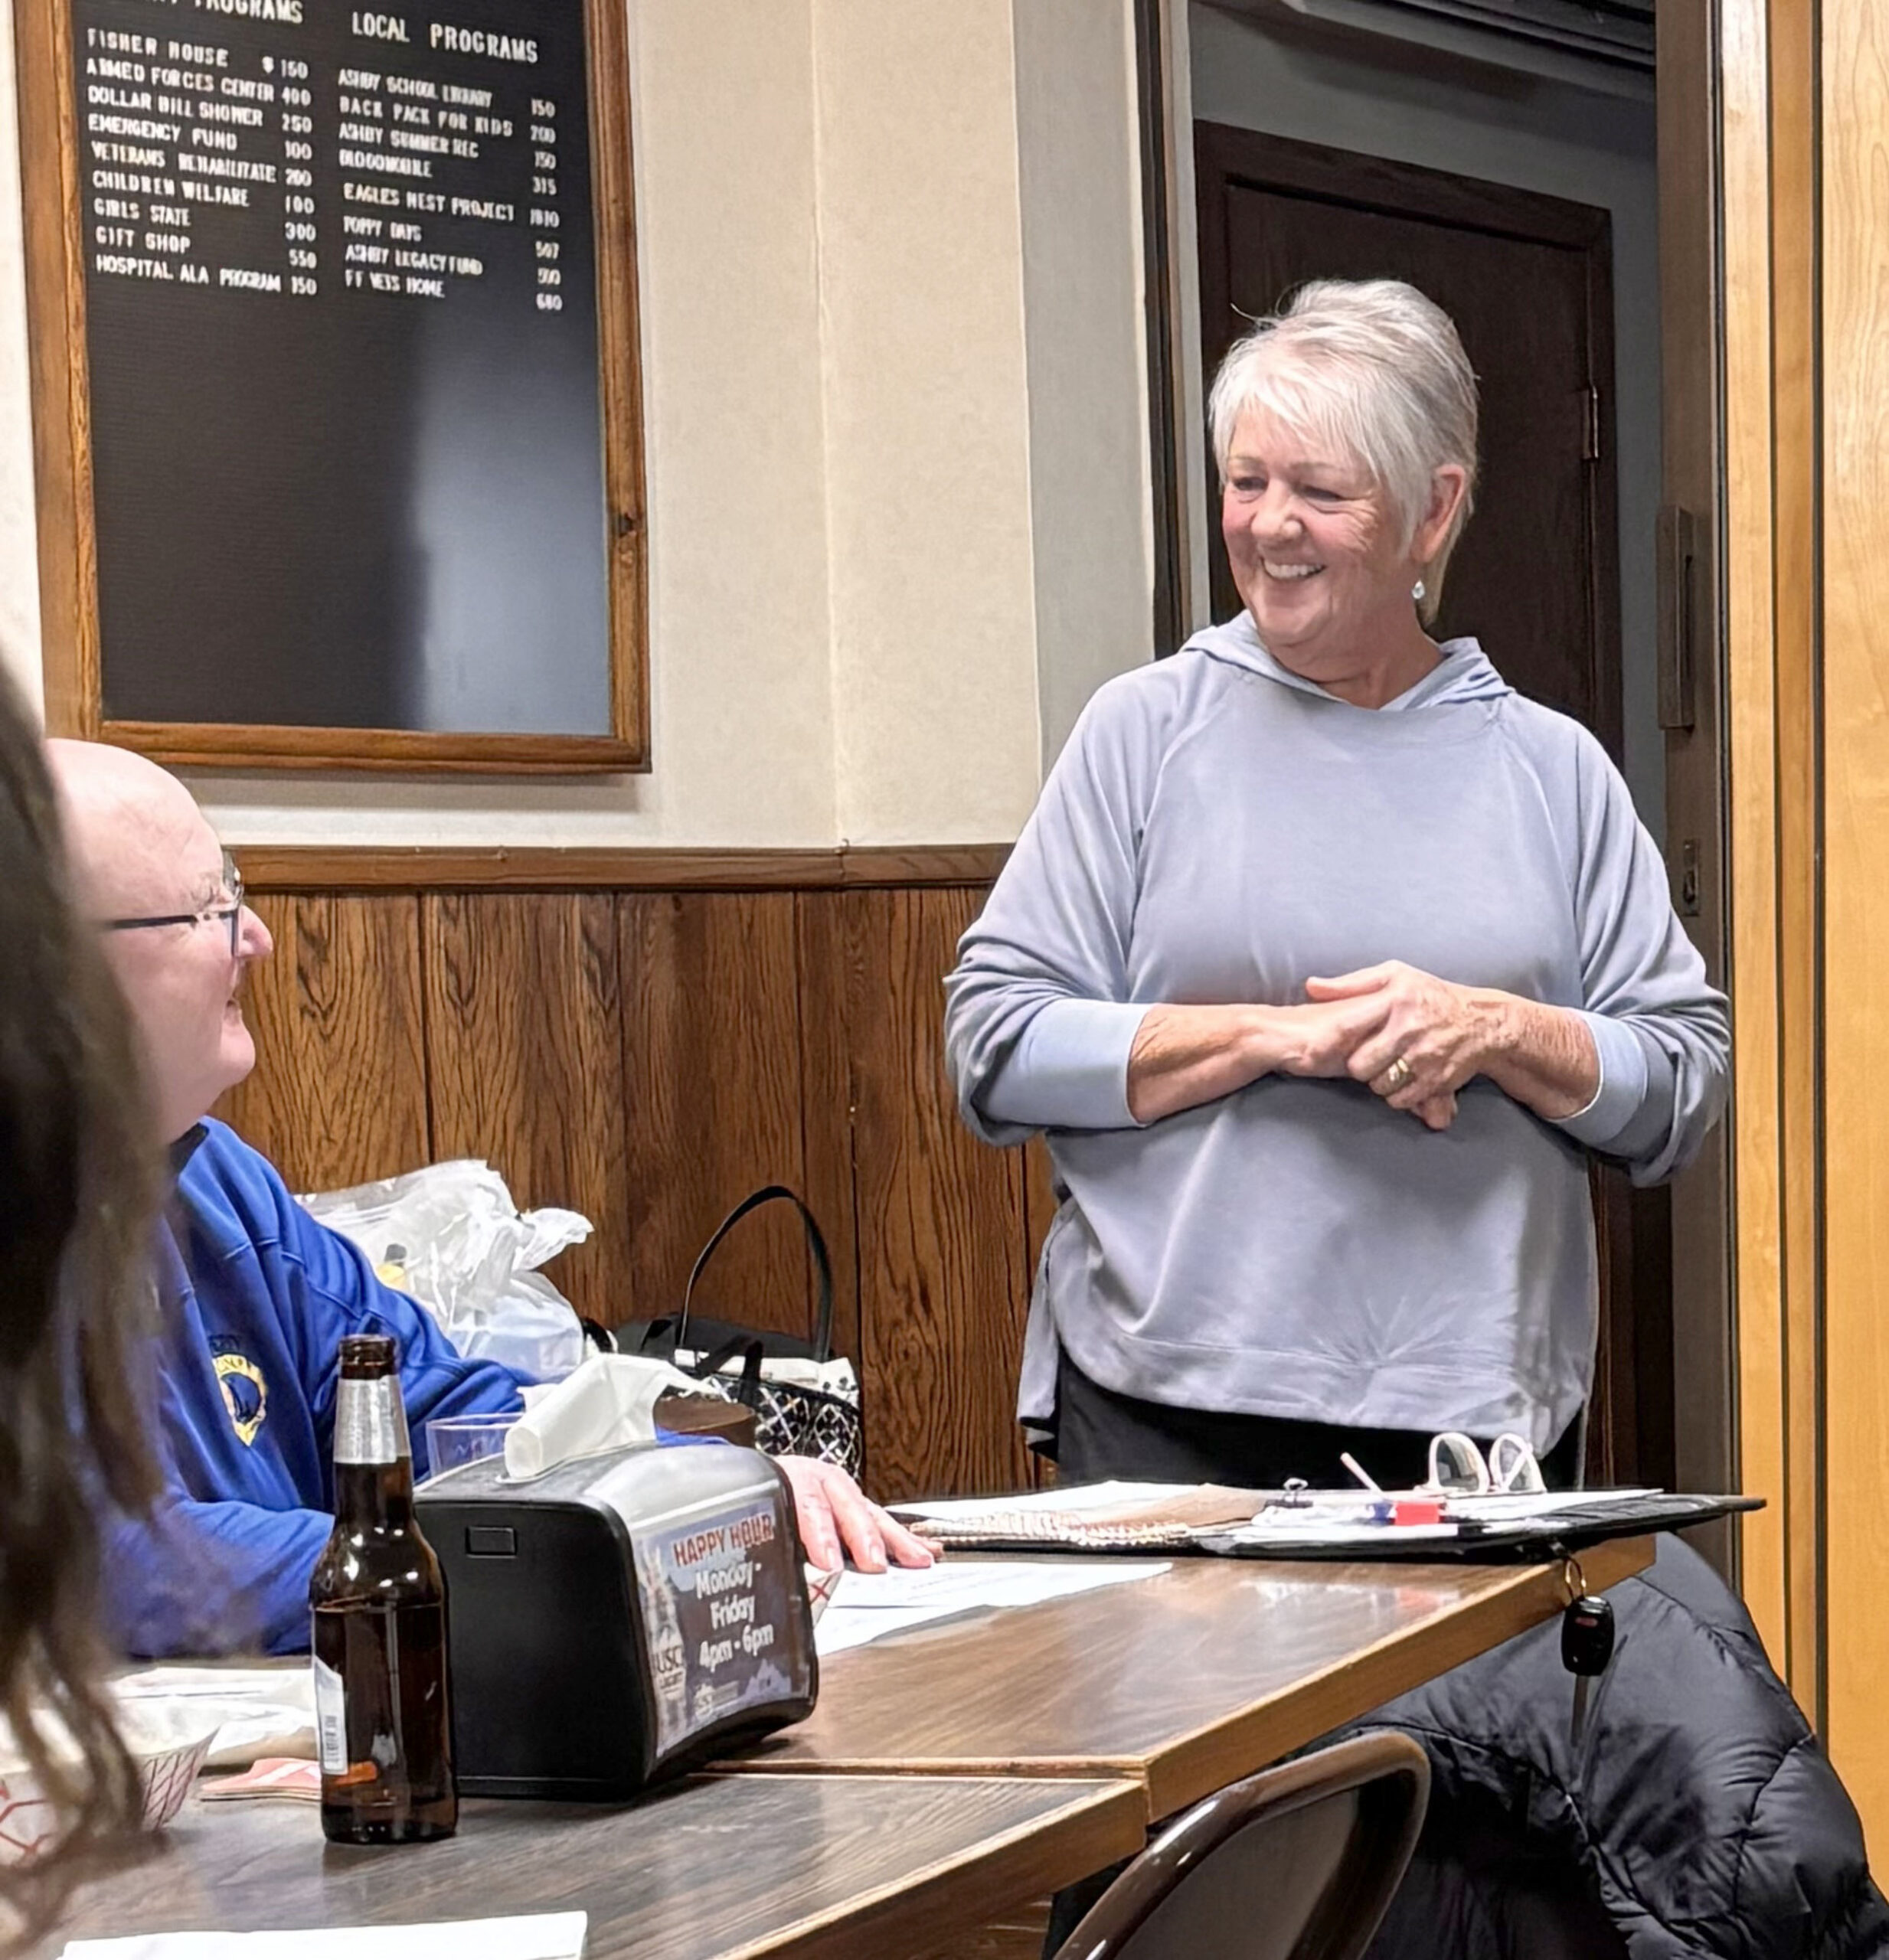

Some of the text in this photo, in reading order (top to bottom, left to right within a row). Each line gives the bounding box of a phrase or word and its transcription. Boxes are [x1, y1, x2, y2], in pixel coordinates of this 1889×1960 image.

[87, 28, 158, 55] FISHER
[168, 41, 229, 67] HOUSE
[352, 11, 538, 63] LOCAL PROGRAMS
[87, 58, 312, 106] ARMED FORCES CENTER 400
[338, 69, 556, 118] ASHBY SCHOOL LIBRARY 150
[87, 86, 312, 134] DOLLAR BILL SHOWER 250
[339, 96, 383, 118] BACK
[393, 103, 430, 125] PACK
[438, 110, 467, 131] FOR
[475, 116, 513, 137] KIDS
[88, 113, 312, 160] EMERGENCY FUND 100
[338, 122, 383, 145] ASHBY
[391, 129, 449, 154] SUMMER
[453, 139, 479, 158] REC
[91, 141, 312, 187] VETERANS REHABILITATE 200
[93, 170, 315, 214] CHILDREN WELFARE 100
[344, 182, 400, 206] EAGLES
[407, 191, 446, 212] NEST
[451, 198, 514, 221] PROJECT
[533, 176, 557, 195] 315
[93, 198, 316, 242] GIRLS STATE 300
[344, 215, 382, 237] POPPY
[391, 222, 422, 242] DAYS
[95, 226, 317, 269] GIFT SHOP 550
[345, 243, 389, 264] ASHBY
[395, 249, 446, 273] LEGACY
[449, 256, 483, 276] FUND
[96, 255, 318, 296] HOSPITAL ALA PROGRAM 150
[370, 272, 400, 292] VETS
[407, 277, 446, 298] HOME
[673, 1513, 775, 1567] HAPPY HOUR
[695, 1561, 753, 1600] Monday
[710, 1595, 755, 1630] Friday
[699, 1640, 733, 1674] 4pm
[742, 1623, 774, 1658] 6pm
